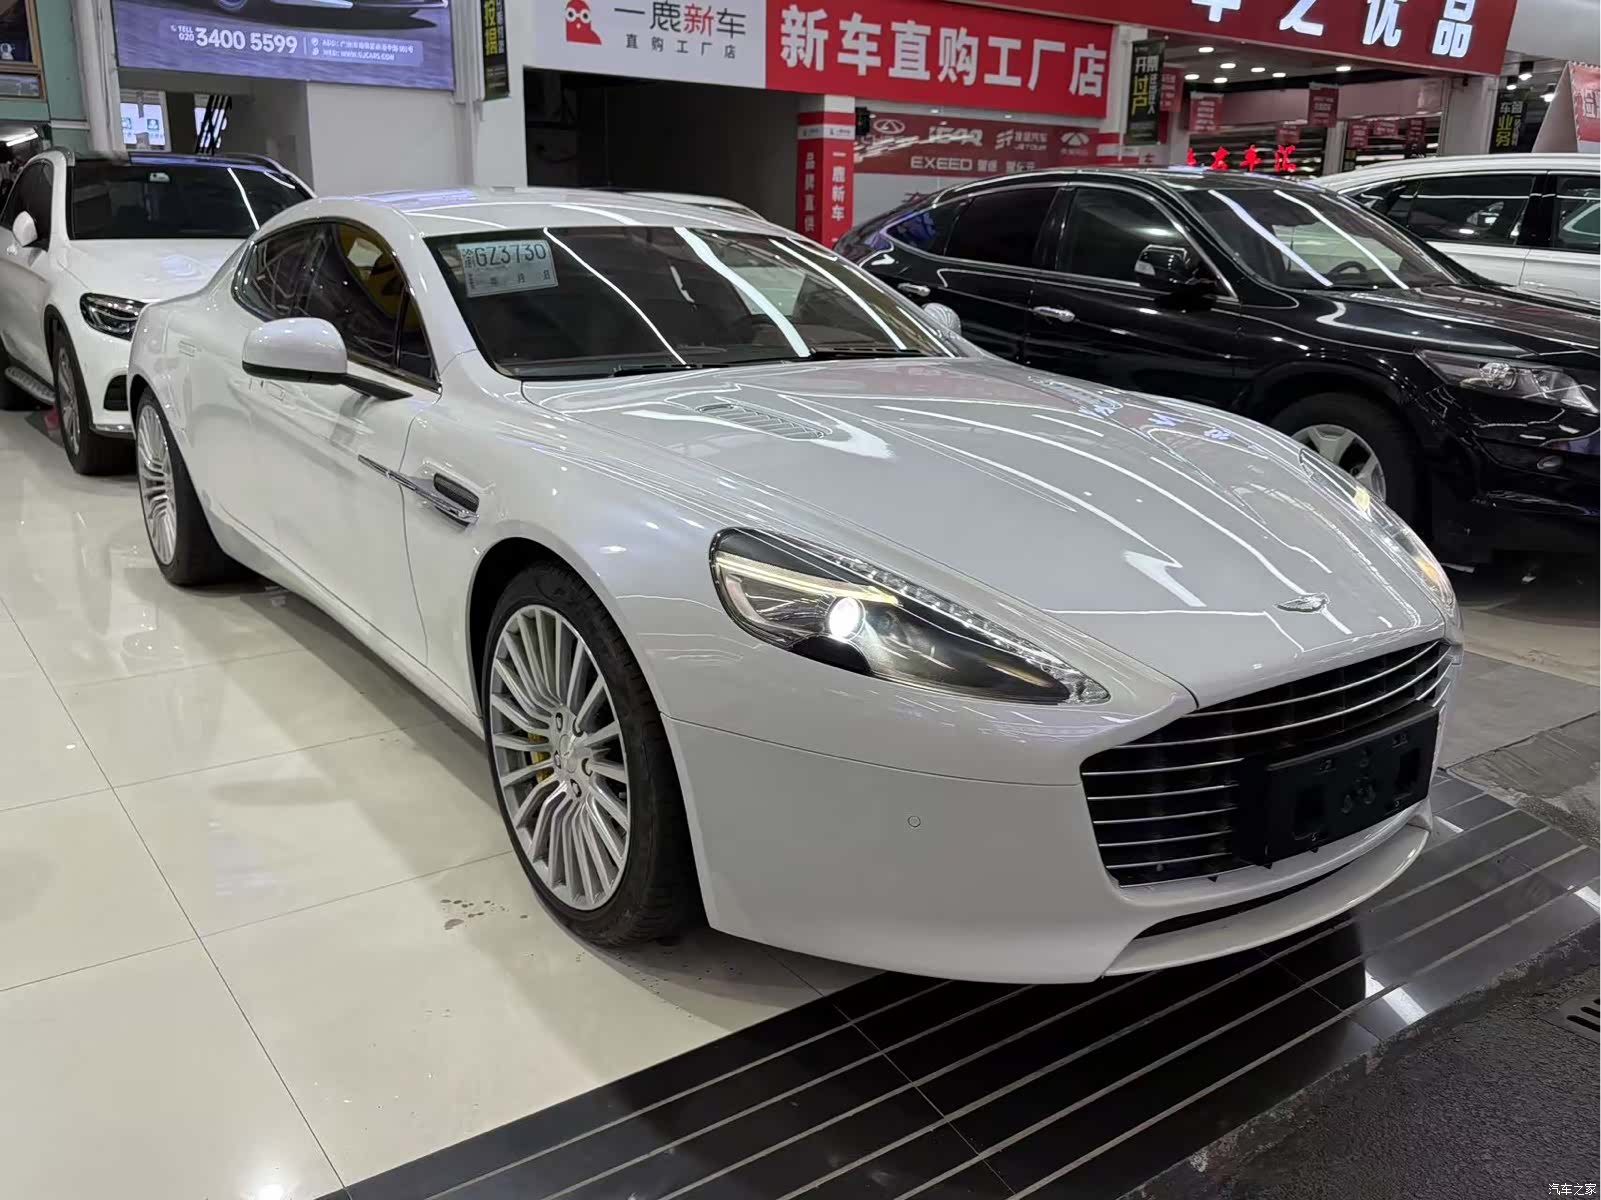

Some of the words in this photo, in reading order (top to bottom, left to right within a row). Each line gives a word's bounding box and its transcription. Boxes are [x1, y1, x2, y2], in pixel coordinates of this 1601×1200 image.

[614, 1, 747, 38] 一鹿新车
[179, 33, 194, 41] 020
[195, 27, 246, 50] 3400
[250, 32, 298, 54] 5599
[626, 34, 736, 59] 直购工厂店
[780, 5, 1107, 97] 新车直购工厂店
[1131, 75, 1149, 115] 过户
[910, 156, 973, 171] EXEED
[832, 151, 847, 222] 一鹿新车
[474, 243, 547, 267] GZ3730
